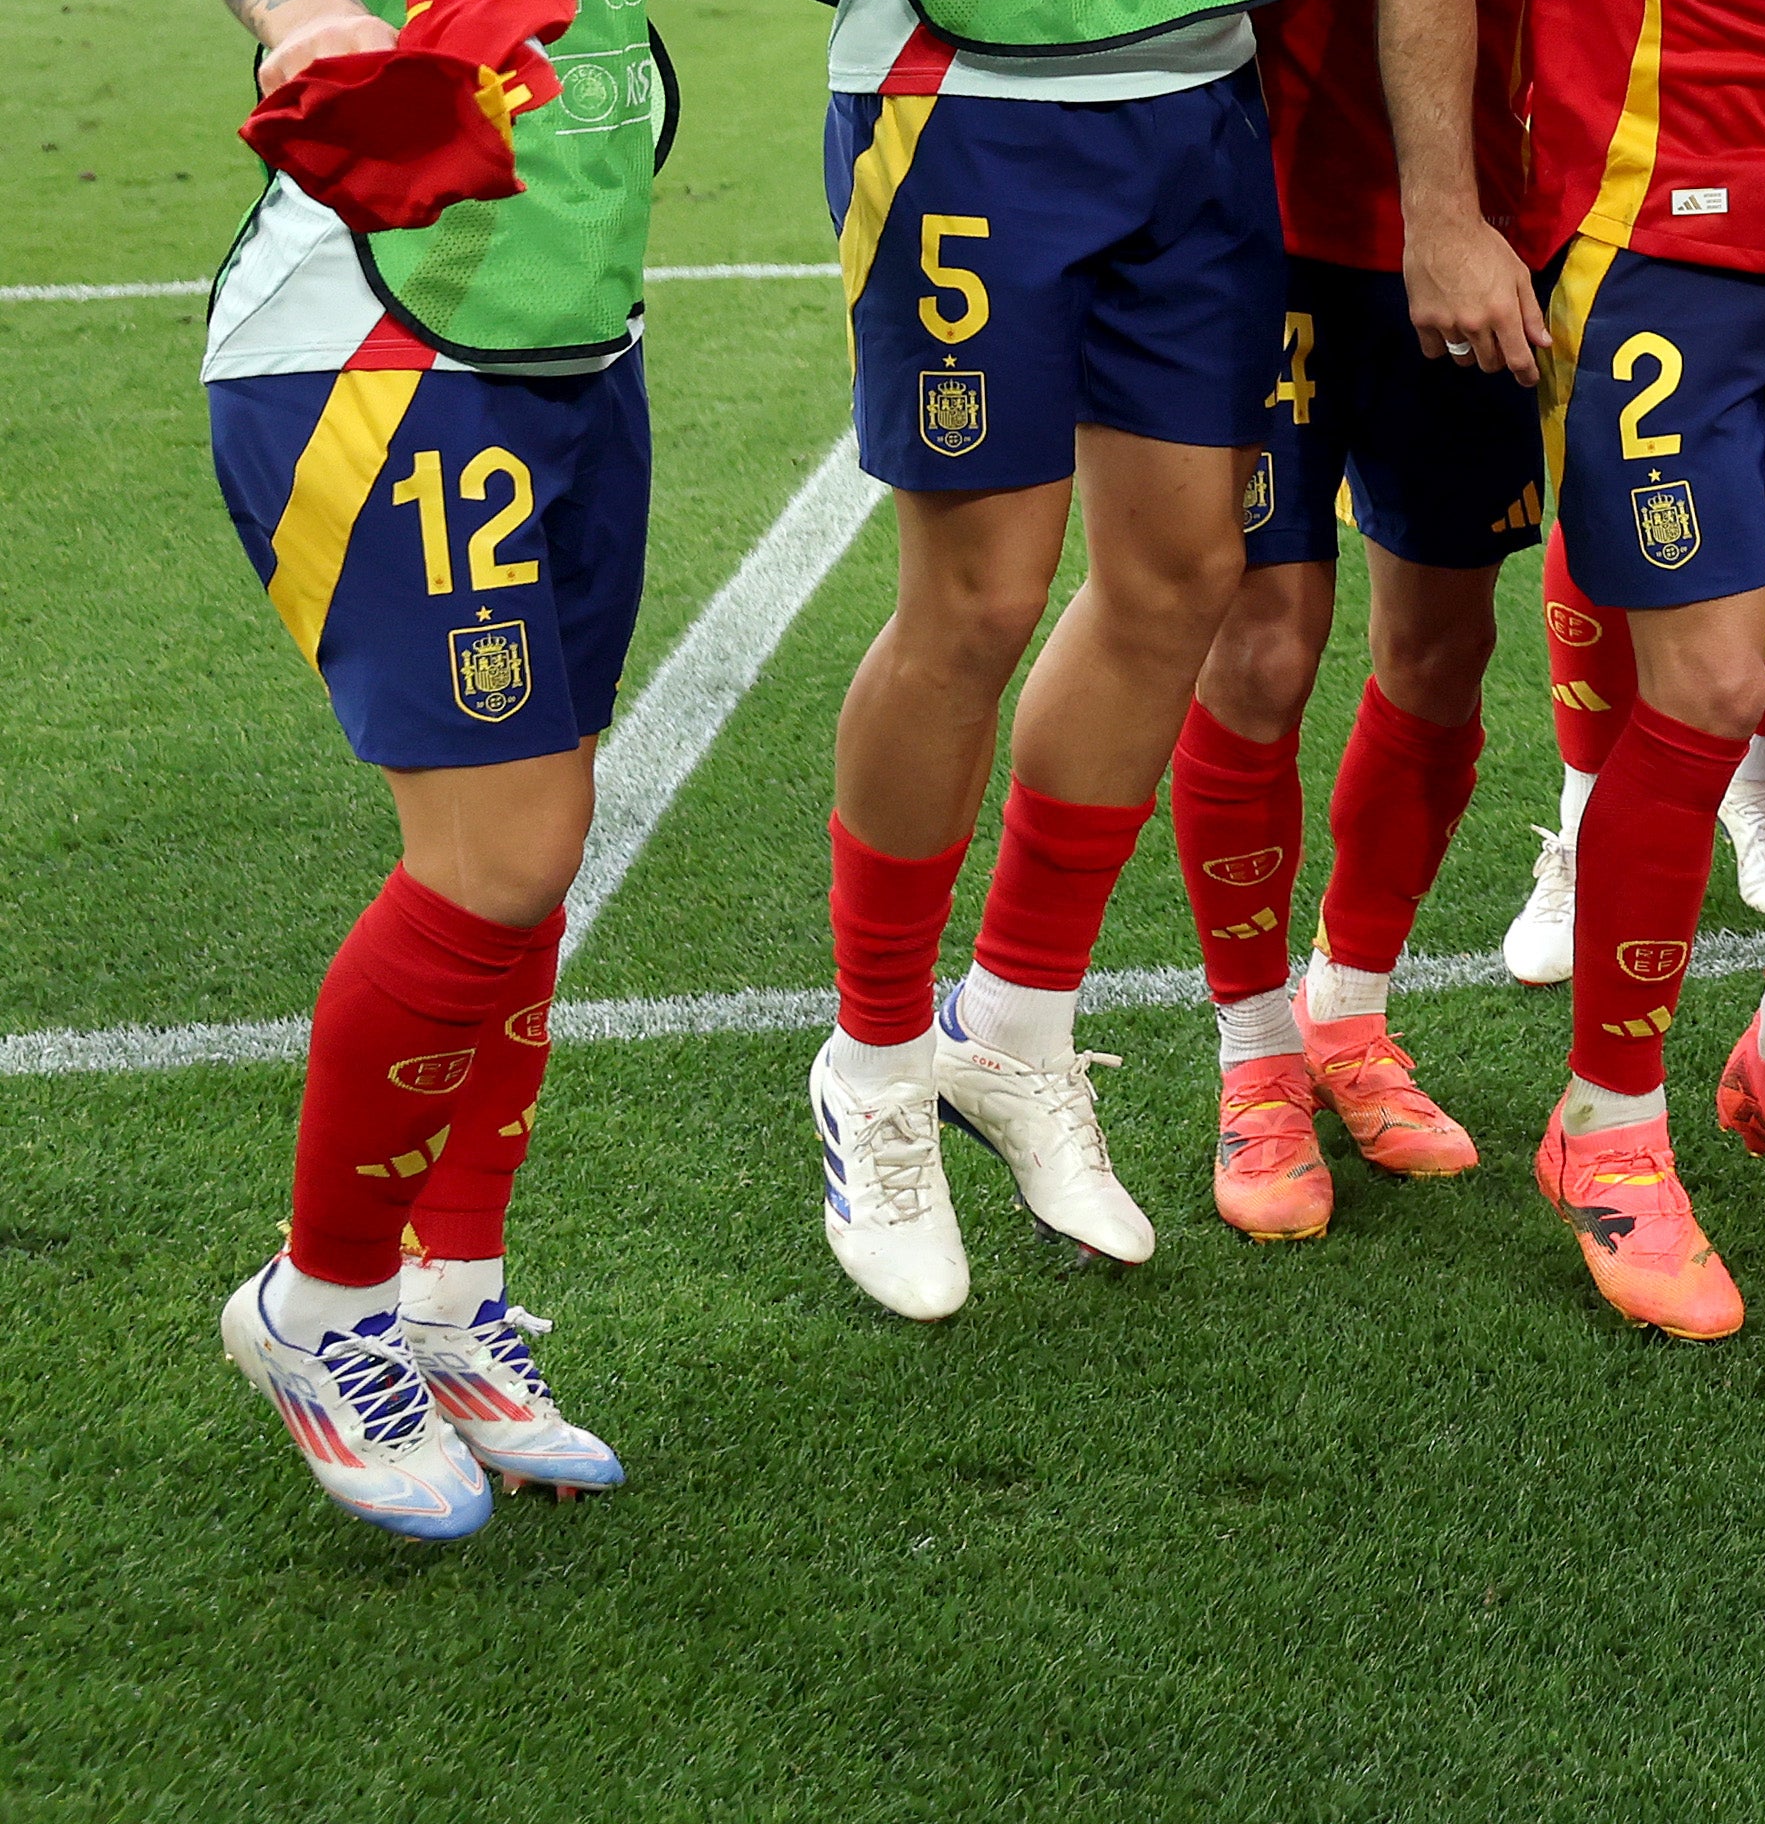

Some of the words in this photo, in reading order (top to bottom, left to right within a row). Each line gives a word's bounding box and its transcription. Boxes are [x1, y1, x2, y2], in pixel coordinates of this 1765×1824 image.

[918, 214, 990, 344] 5
[1613, 331, 1684, 460] 2
[392, 446, 540, 596] 12
[972, 1054, 1002, 1072] COPA
